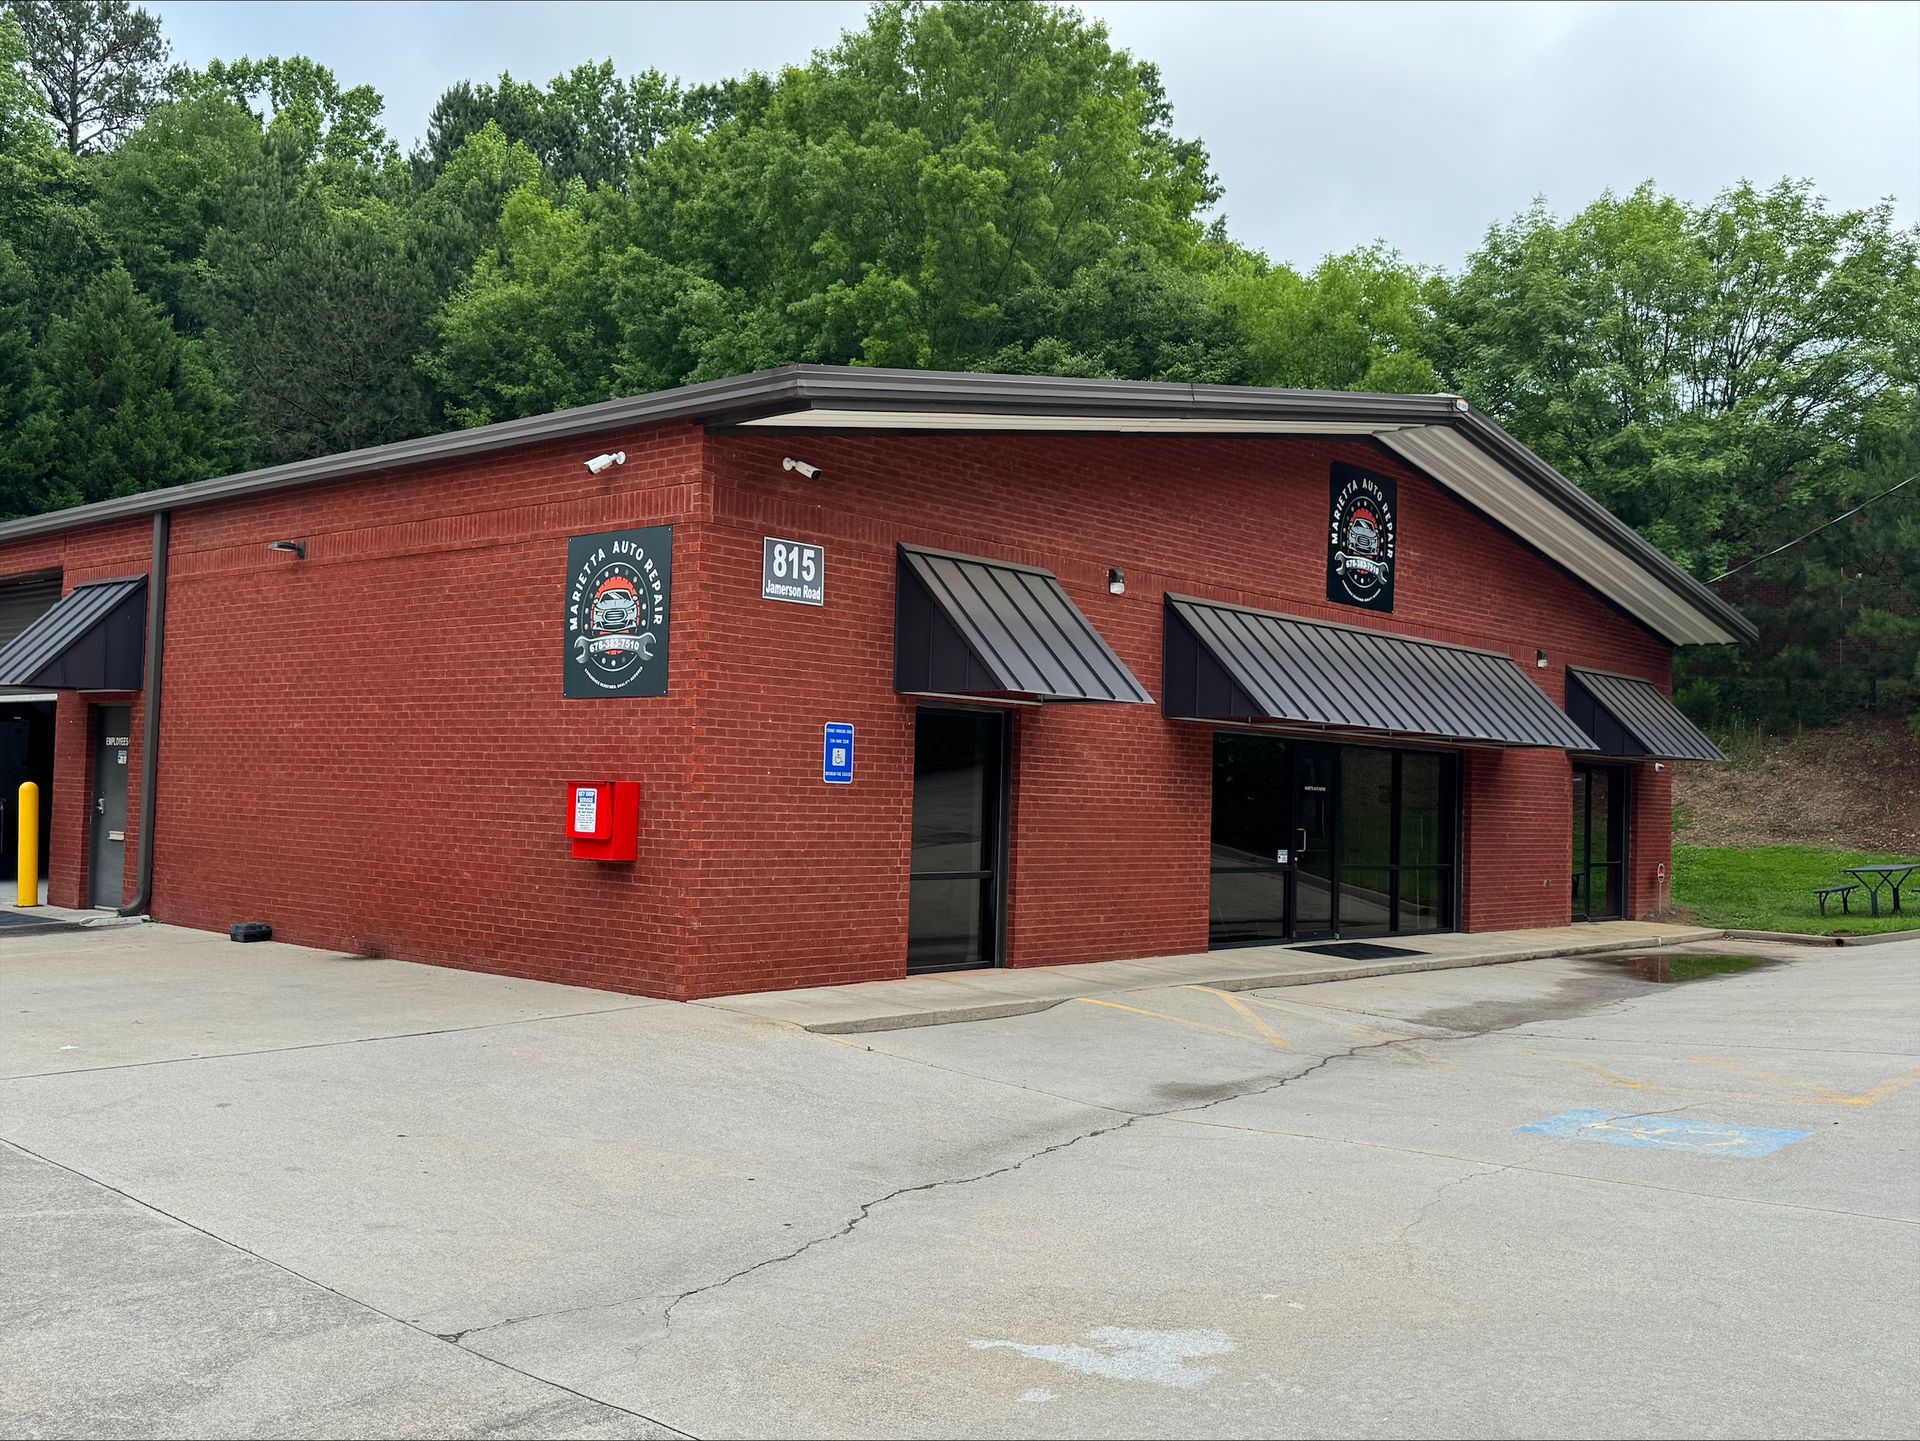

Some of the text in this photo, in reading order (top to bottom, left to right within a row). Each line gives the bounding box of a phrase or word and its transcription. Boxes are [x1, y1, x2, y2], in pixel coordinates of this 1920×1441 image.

[1331, 478, 1394, 559] MARIETTA AUTO REPAIR
[773, 543, 816, 582] 815
[569, 540, 663, 631] MARIETTA AUTO REPAIR
[766, 579, 821, 600] Jamerson Road
[589, 638, 640, 653] 678-383-7510
